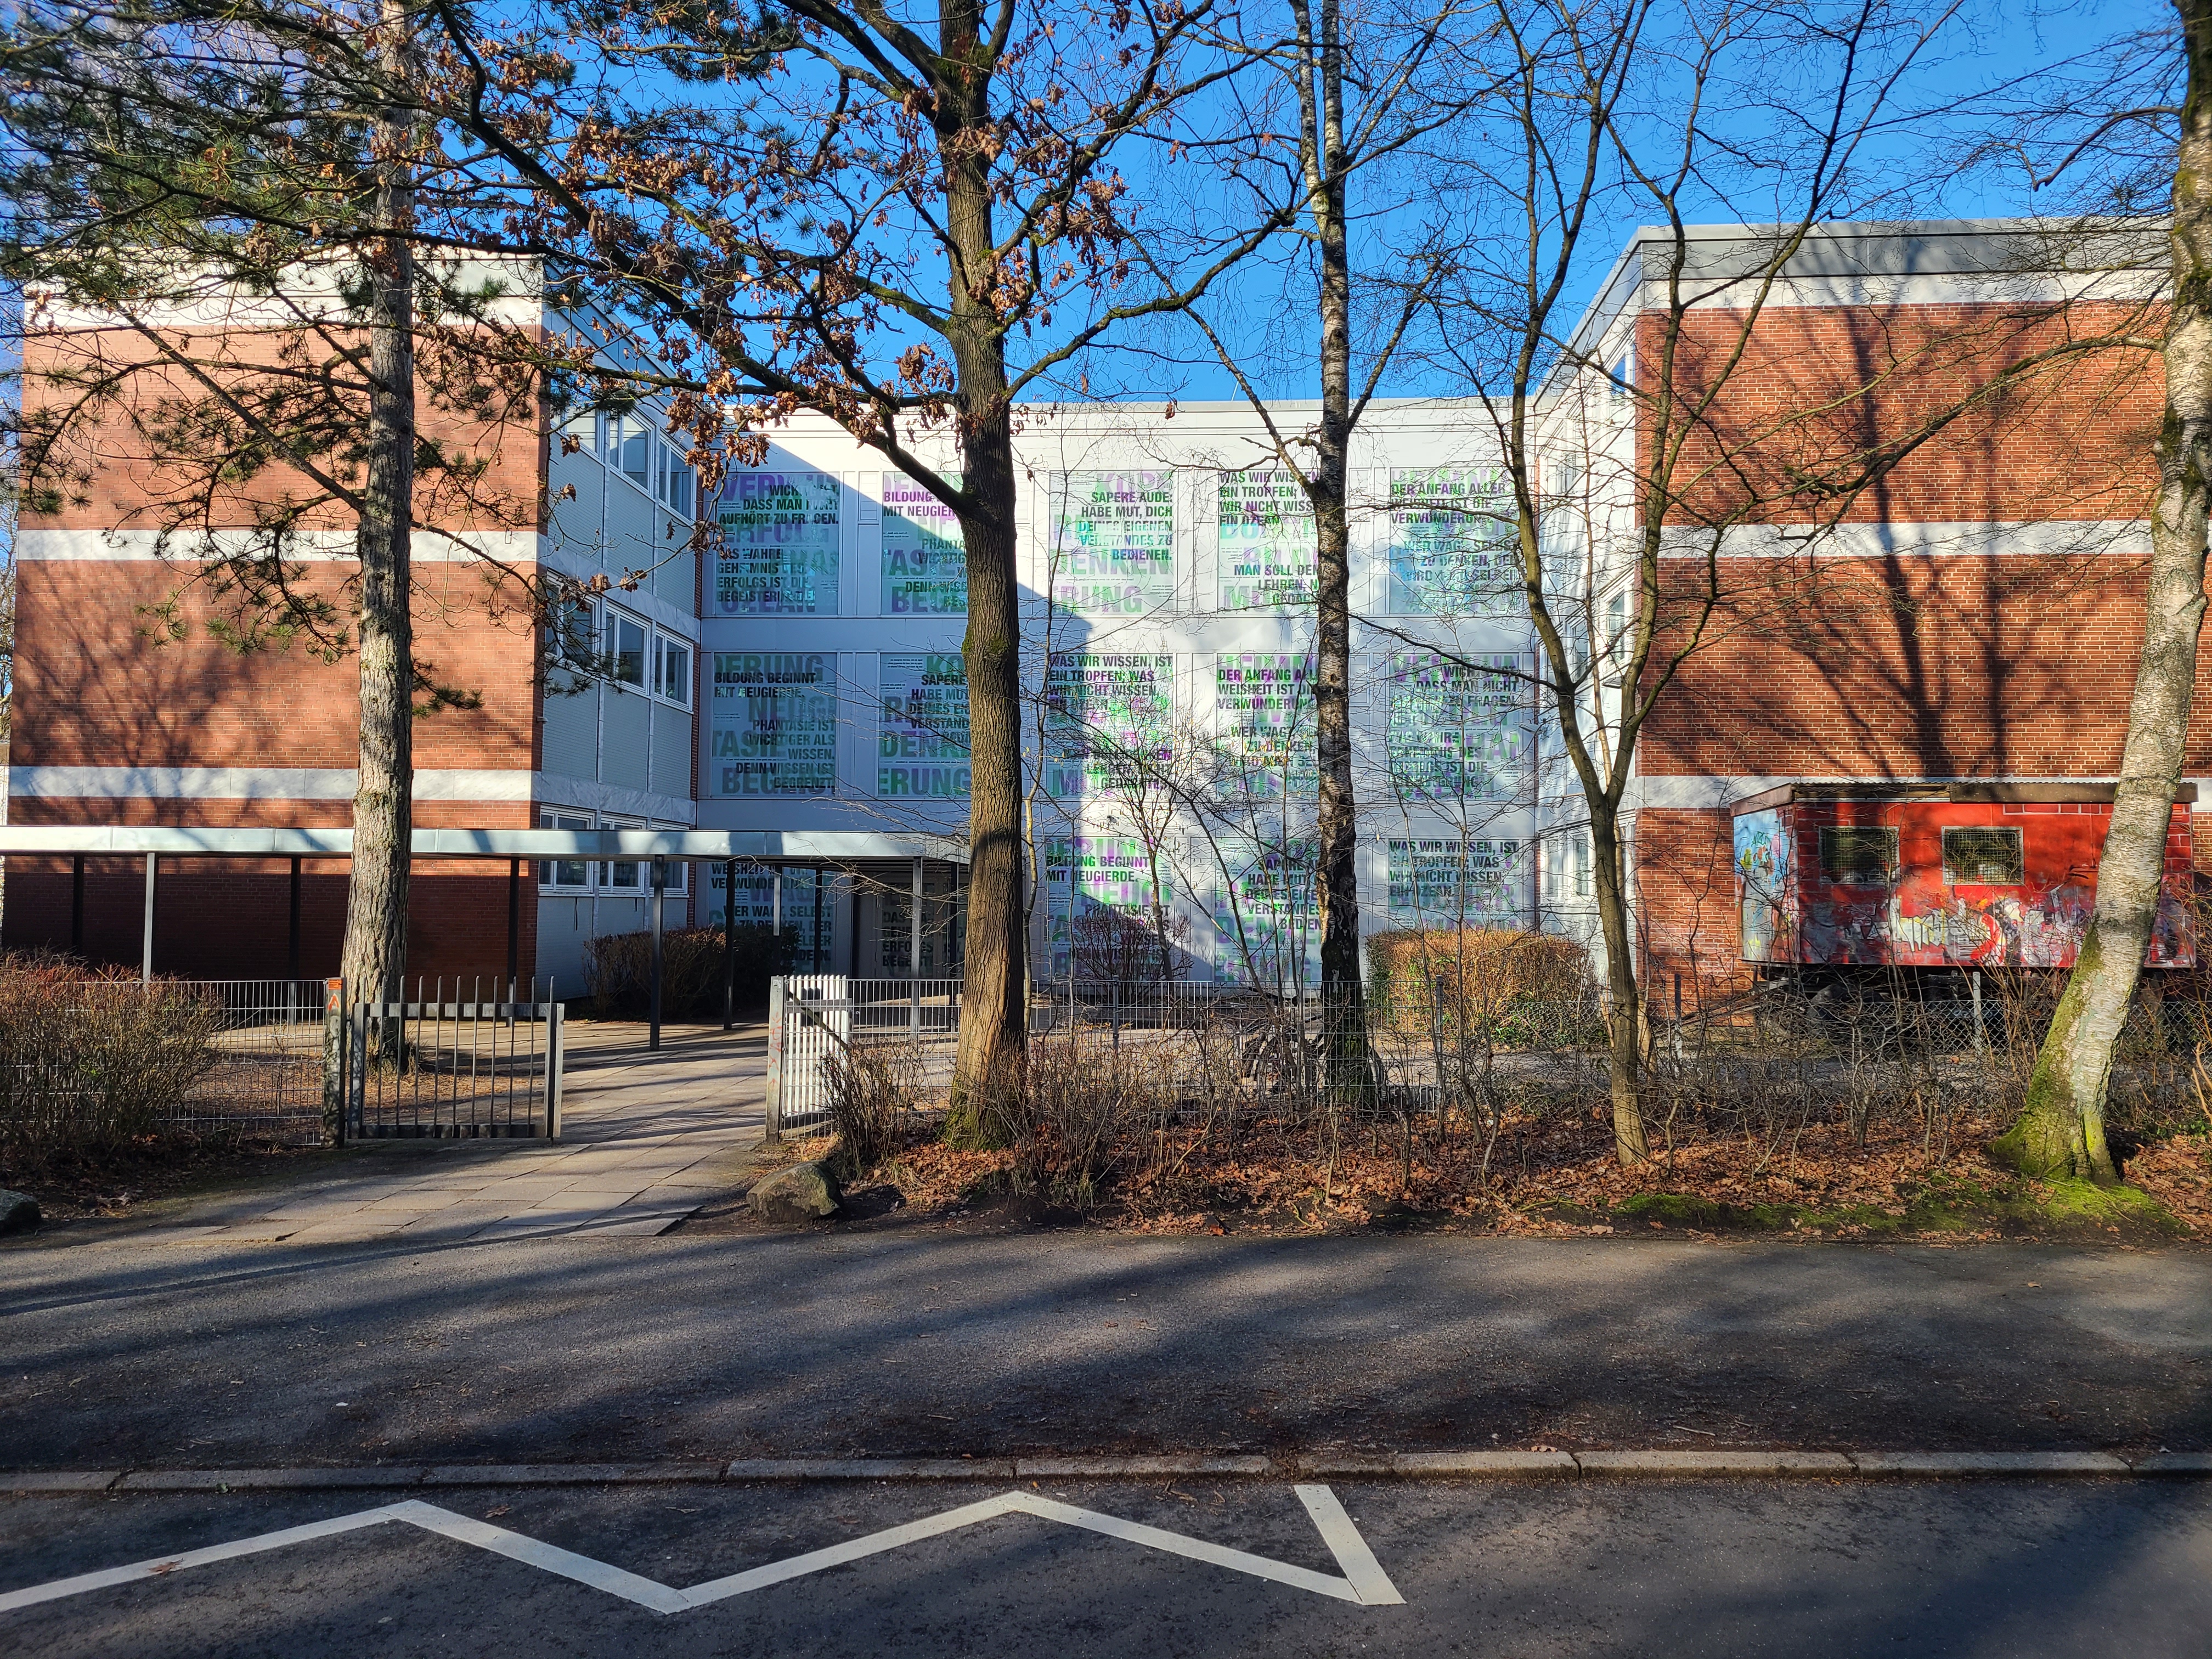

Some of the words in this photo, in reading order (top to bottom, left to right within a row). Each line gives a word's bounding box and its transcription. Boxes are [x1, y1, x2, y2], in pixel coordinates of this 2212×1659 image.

[1220, 472, 1245, 483] WAS
[1249, 472, 1271, 483] WIR
[1220, 487, 1238, 498] EIN
[1419, 483, 1465, 494] ANFANG
[884, 492, 932, 502] BILDUNG
[1091, 492, 1136, 503] SAPERE
[743, 499, 772, 510] DASS
[777, 499, 802, 510] MAN
[1220, 501, 1241, 512] WIR
[1246, 501, 1280, 511] NICHT
[884, 506, 904, 516] MIT
[1081, 506, 1111, 517] HABE
[1115, 506, 1142, 519] MUT,
[1146, 506, 1172, 517] DICH
[719, 511, 771, 524] AUFHÖRT
[774, 514, 788, 524] ZU
[1113, 549, 1172, 560] BEDIENEN.
[1234, 565, 1260, 575] MAN
[718, 577, 766, 588] ERFOLGS
[1049, 656, 1076, 667] WAS
[1077, 656, 1099, 667] WIR
[1155, 656, 1173, 667] IST
[715, 673, 764, 684] BILDUNG
[767, 673, 816, 684] BEGINNT
[1049, 670, 1066, 681] EIN
[1129, 670, 1154, 681] WAS
[1218, 669, 1241, 680] DER
[1245, 669, 1291, 680] ANFANG
[1218, 684, 1273, 695] WEISHEIT
[1277, 684, 1294, 695] IST
[1417, 681, 1446, 692] DASS
[911, 689, 942, 699] HABE
[753, 720, 815, 731] PHANTASIE
[818, 720, 835, 731] IST
[1231, 726, 1256, 737] WER
[749, 734, 810, 745] WICHTIGER
[814, 734, 835, 745] ALS
[788, 749, 835, 760] WISSEN.
[736, 763, 768, 774] DENN
[770, 763, 814, 774] WISSEN
[817, 763, 834, 774] IST
[1468, 761, 1487, 772] DIE
[774, 777, 835, 788] BEGRENZT.
[1390, 841, 1416, 853] WAS
[1419, 841, 1442, 853] WIR
[1500, 841, 1519, 853] IST
[1100, 856, 1149, 867] BEGINNT
[1473, 856, 1499, 867] WAS
[1046, 871, 1067, 882] MIT
[1417, 871, 1452, 882] NICHT
